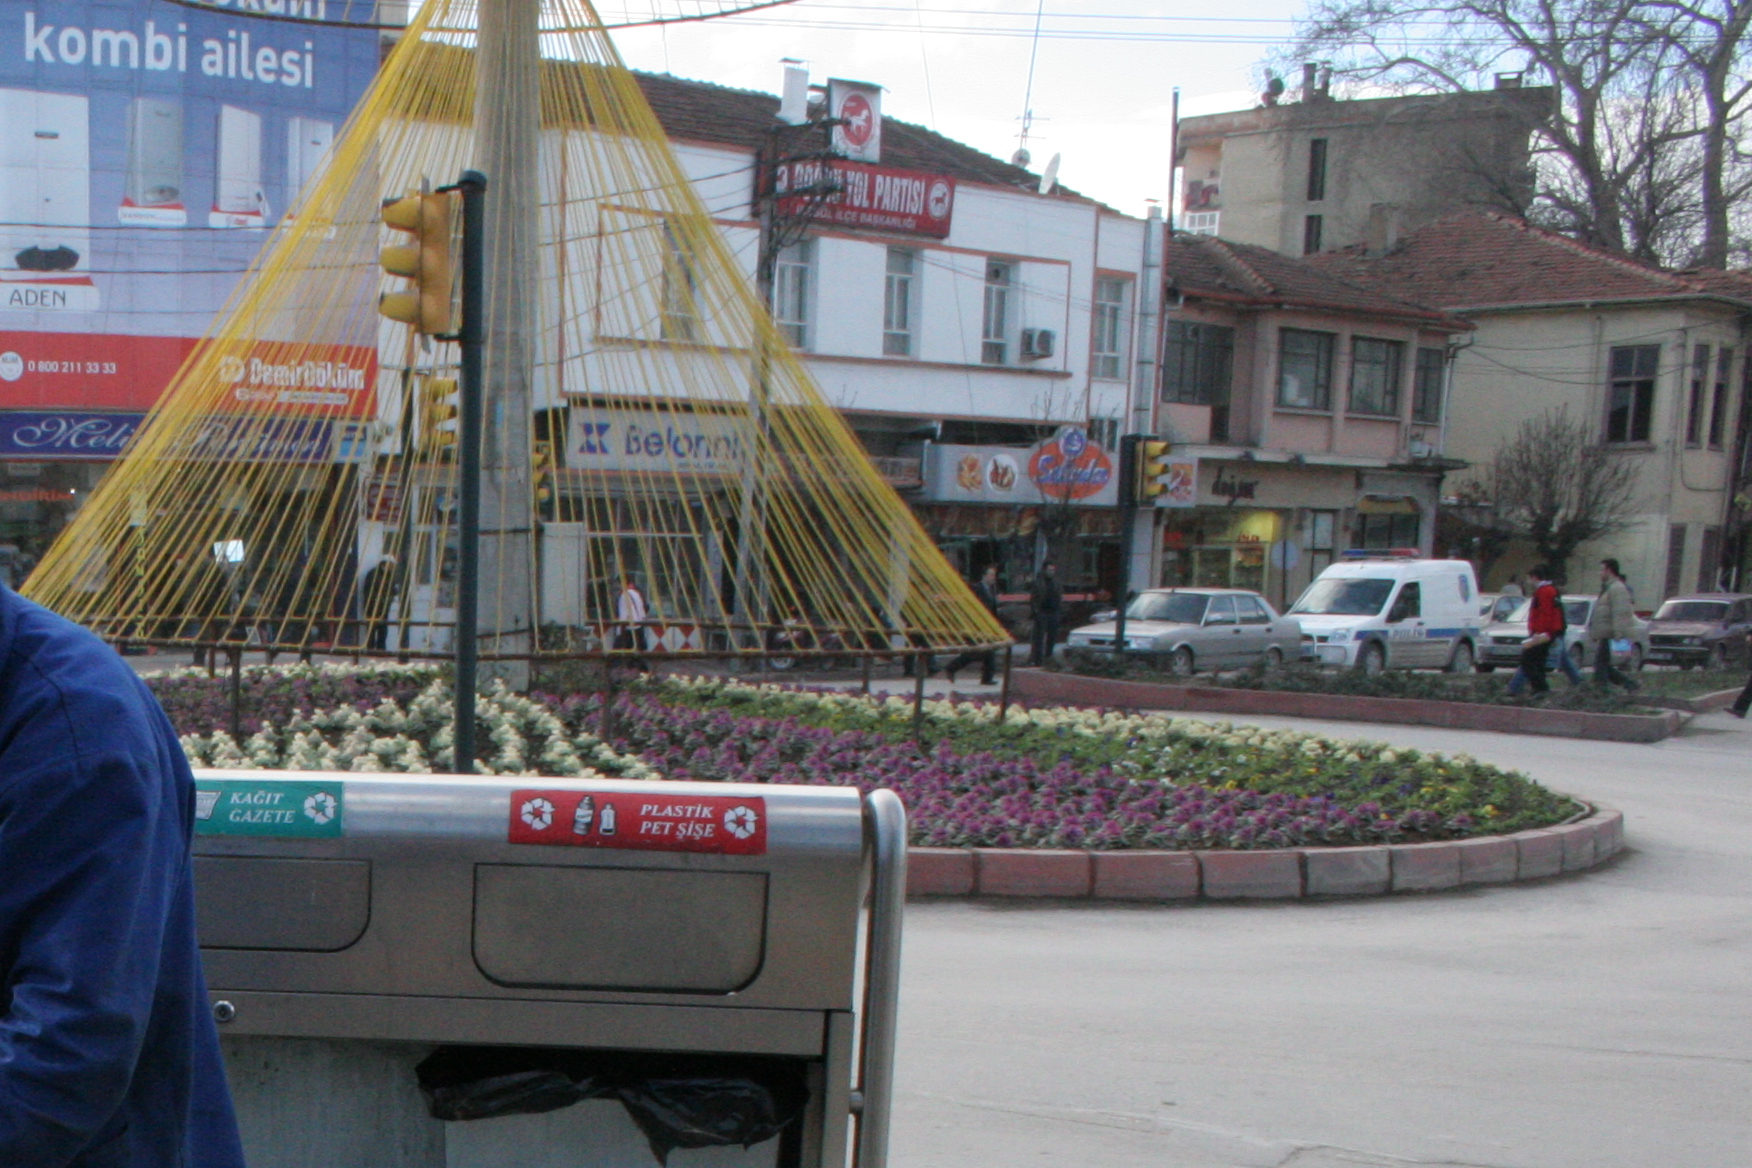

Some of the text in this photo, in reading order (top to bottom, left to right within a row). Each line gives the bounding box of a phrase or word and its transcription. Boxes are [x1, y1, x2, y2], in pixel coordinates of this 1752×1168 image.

[24, 11, 313, 88] kombi ailesi
[846, 170, 870, 208] YOL
[873, 174, 926, 215] PARTİSİ
[9, 289, 66, 307] ADEN
[28, 360, 36, 372] 0
[38, 360, 60, 373] 800
[62, 361, 82, 374] 211
[85, 362, 101, 374] 33
[102, 362, 117, 374] 33
[229, 790, 284, 807] KAĞIT
[228, 807, 297, 825] GAZETE
[640, 802, 715, 820] PLASTİK
[639, 818, 716, 841] PET ŞİŞE
